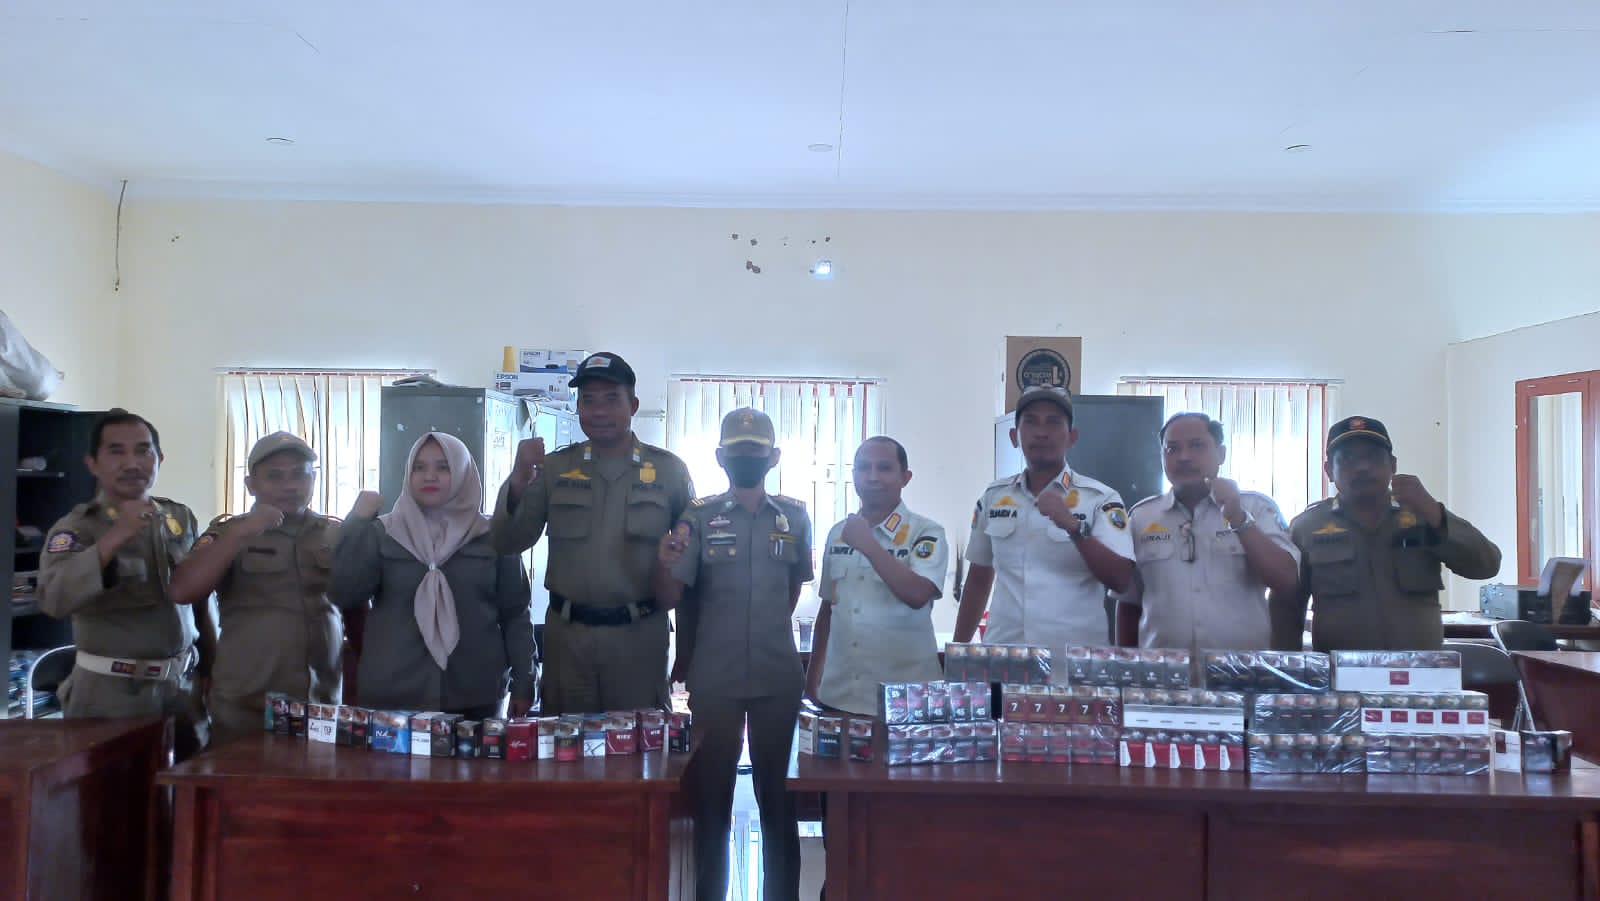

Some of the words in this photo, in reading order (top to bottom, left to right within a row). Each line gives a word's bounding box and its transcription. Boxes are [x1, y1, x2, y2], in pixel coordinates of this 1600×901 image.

[1010, 702, 1018, 711] 7
[1034, 703, 1042, 712] 7
[1058, 704, 1066, 713] 7
[1081, 704, 1089, 714] 7
[1106, 705, 1113, 714] 7
